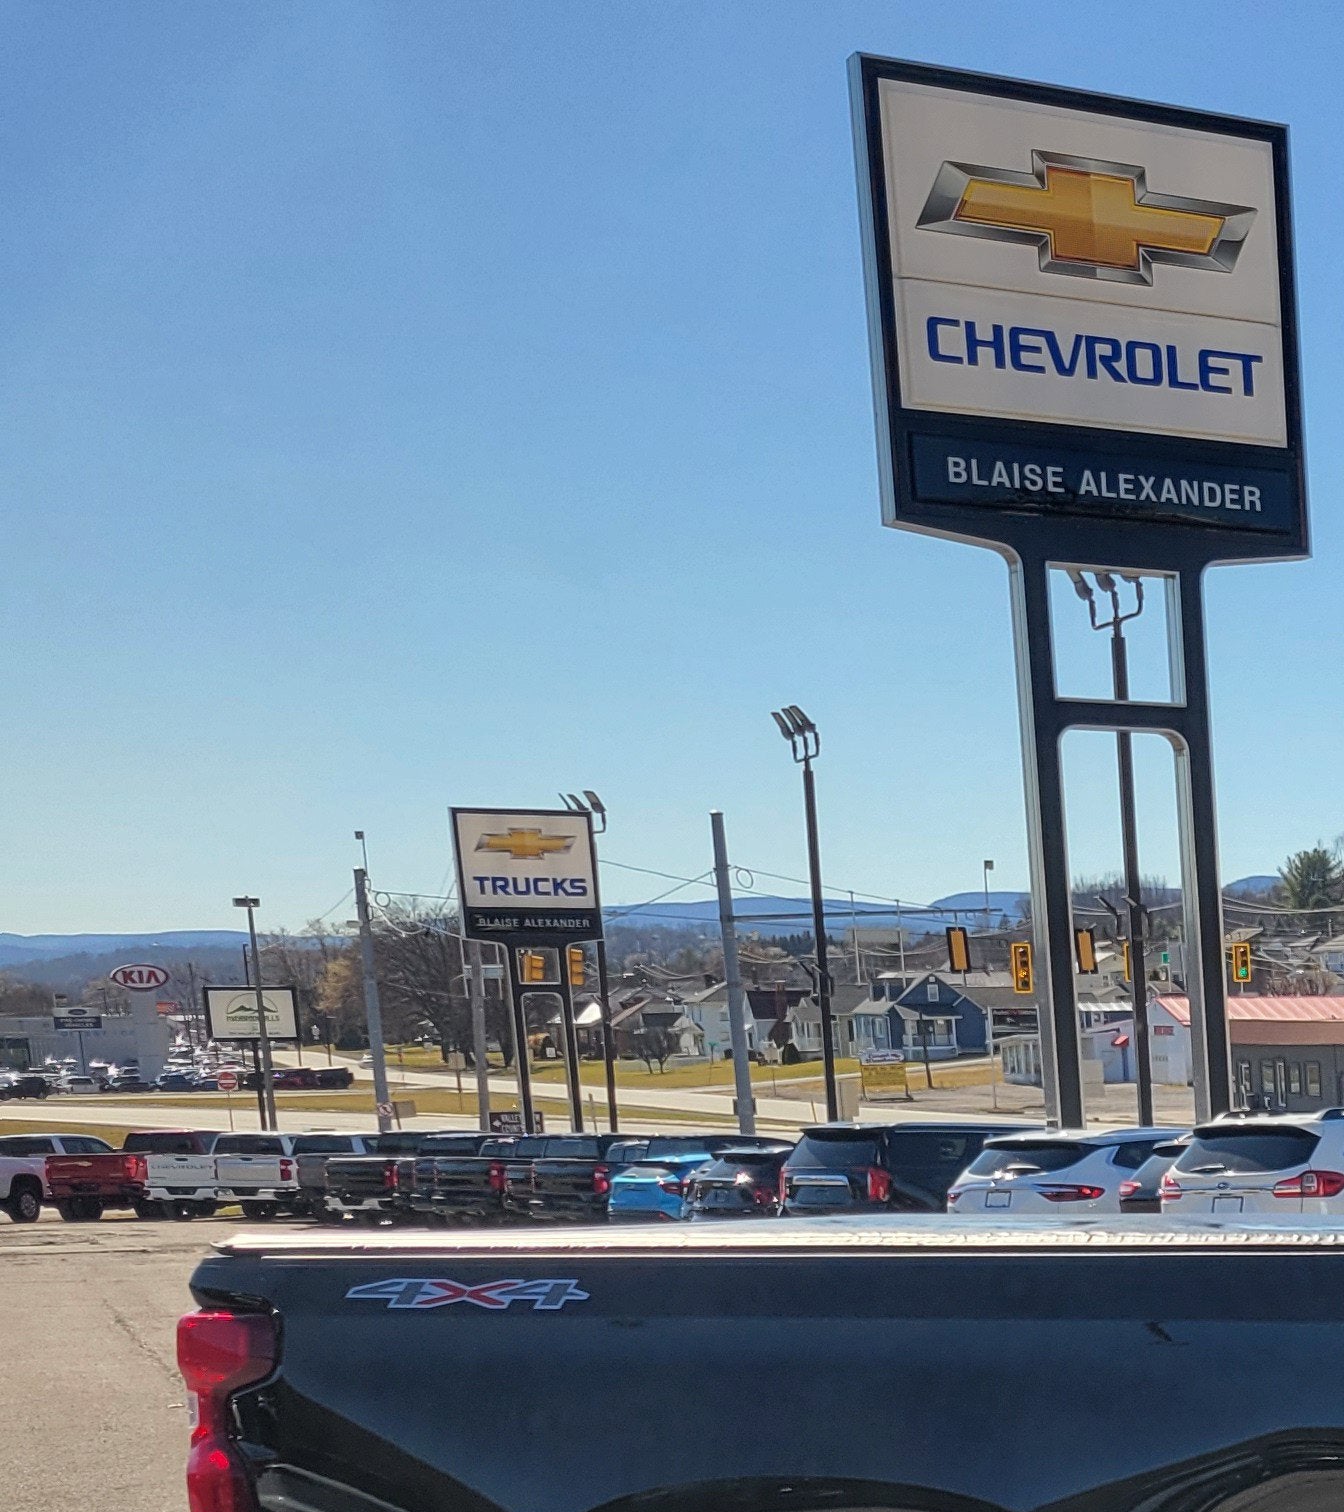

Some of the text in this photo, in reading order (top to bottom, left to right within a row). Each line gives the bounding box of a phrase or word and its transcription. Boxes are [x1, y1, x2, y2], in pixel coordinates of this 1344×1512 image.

[925, 314, 1264, 397] CHEVROLET
[946, 455, 1263, 513] BLAISE ALEXANDER
[472, 875, 588, 897] TRUCKS
[478, 917, 591, 929] BLAISE ALEXANDER
[121, 969, 161, 985] KIA
